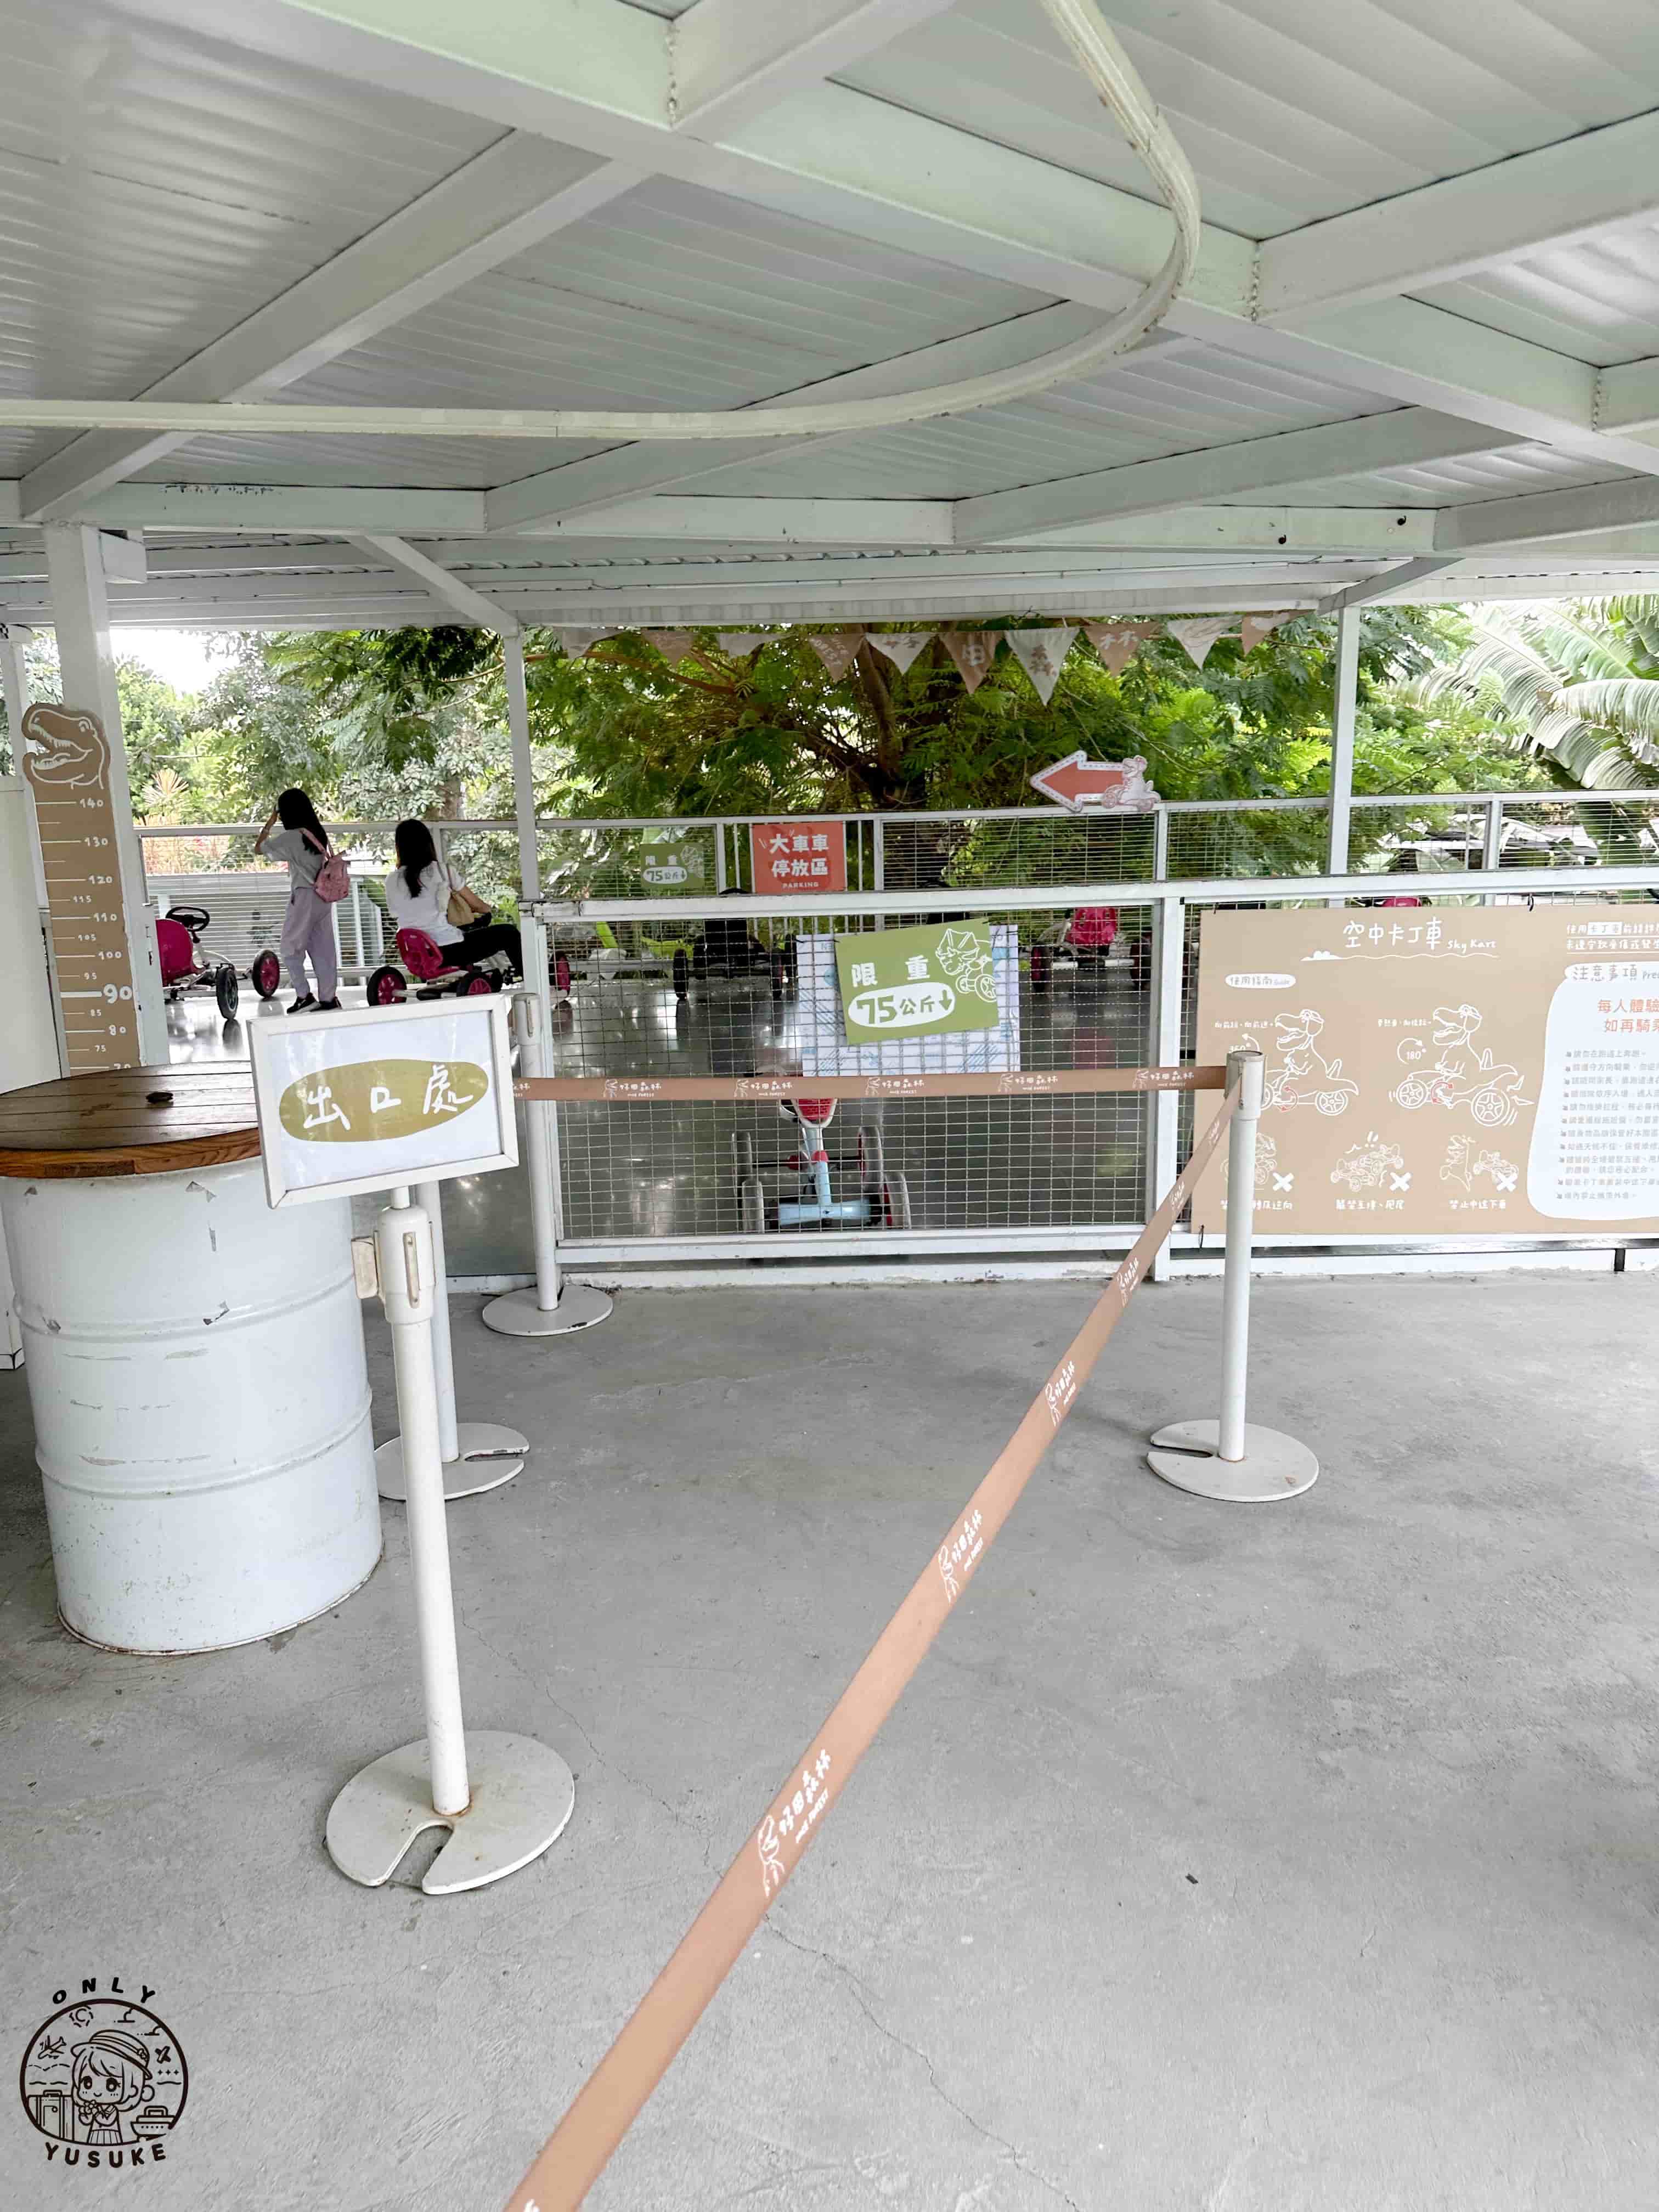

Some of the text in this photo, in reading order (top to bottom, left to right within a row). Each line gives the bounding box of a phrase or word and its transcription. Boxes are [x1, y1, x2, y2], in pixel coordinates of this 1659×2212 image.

[80, 798, 104, 809] 140
[84, 836, 109, 848] 130
[769, 833, 830, 854] 大車車
[772, 857, 828, 878] 停放區
[89, 875, 113, 885] 120
[73, 895, 92, 904] 115
[94, 912, 117, 922] 110
[1343, 916, 1443, 950] 空中卡丁車
[1447, 939, 1497, 954] Sky Kart
[98, 951, 122, 961] 100
[1573, 964, 1638, 981] 注意事項
[103, 984, 133, 1004] 90
[856, 994, 935, 1025] 75公斤
[109, 1024, 127, 1036] 80
[303, 1063, 473, 1130] 出口處
